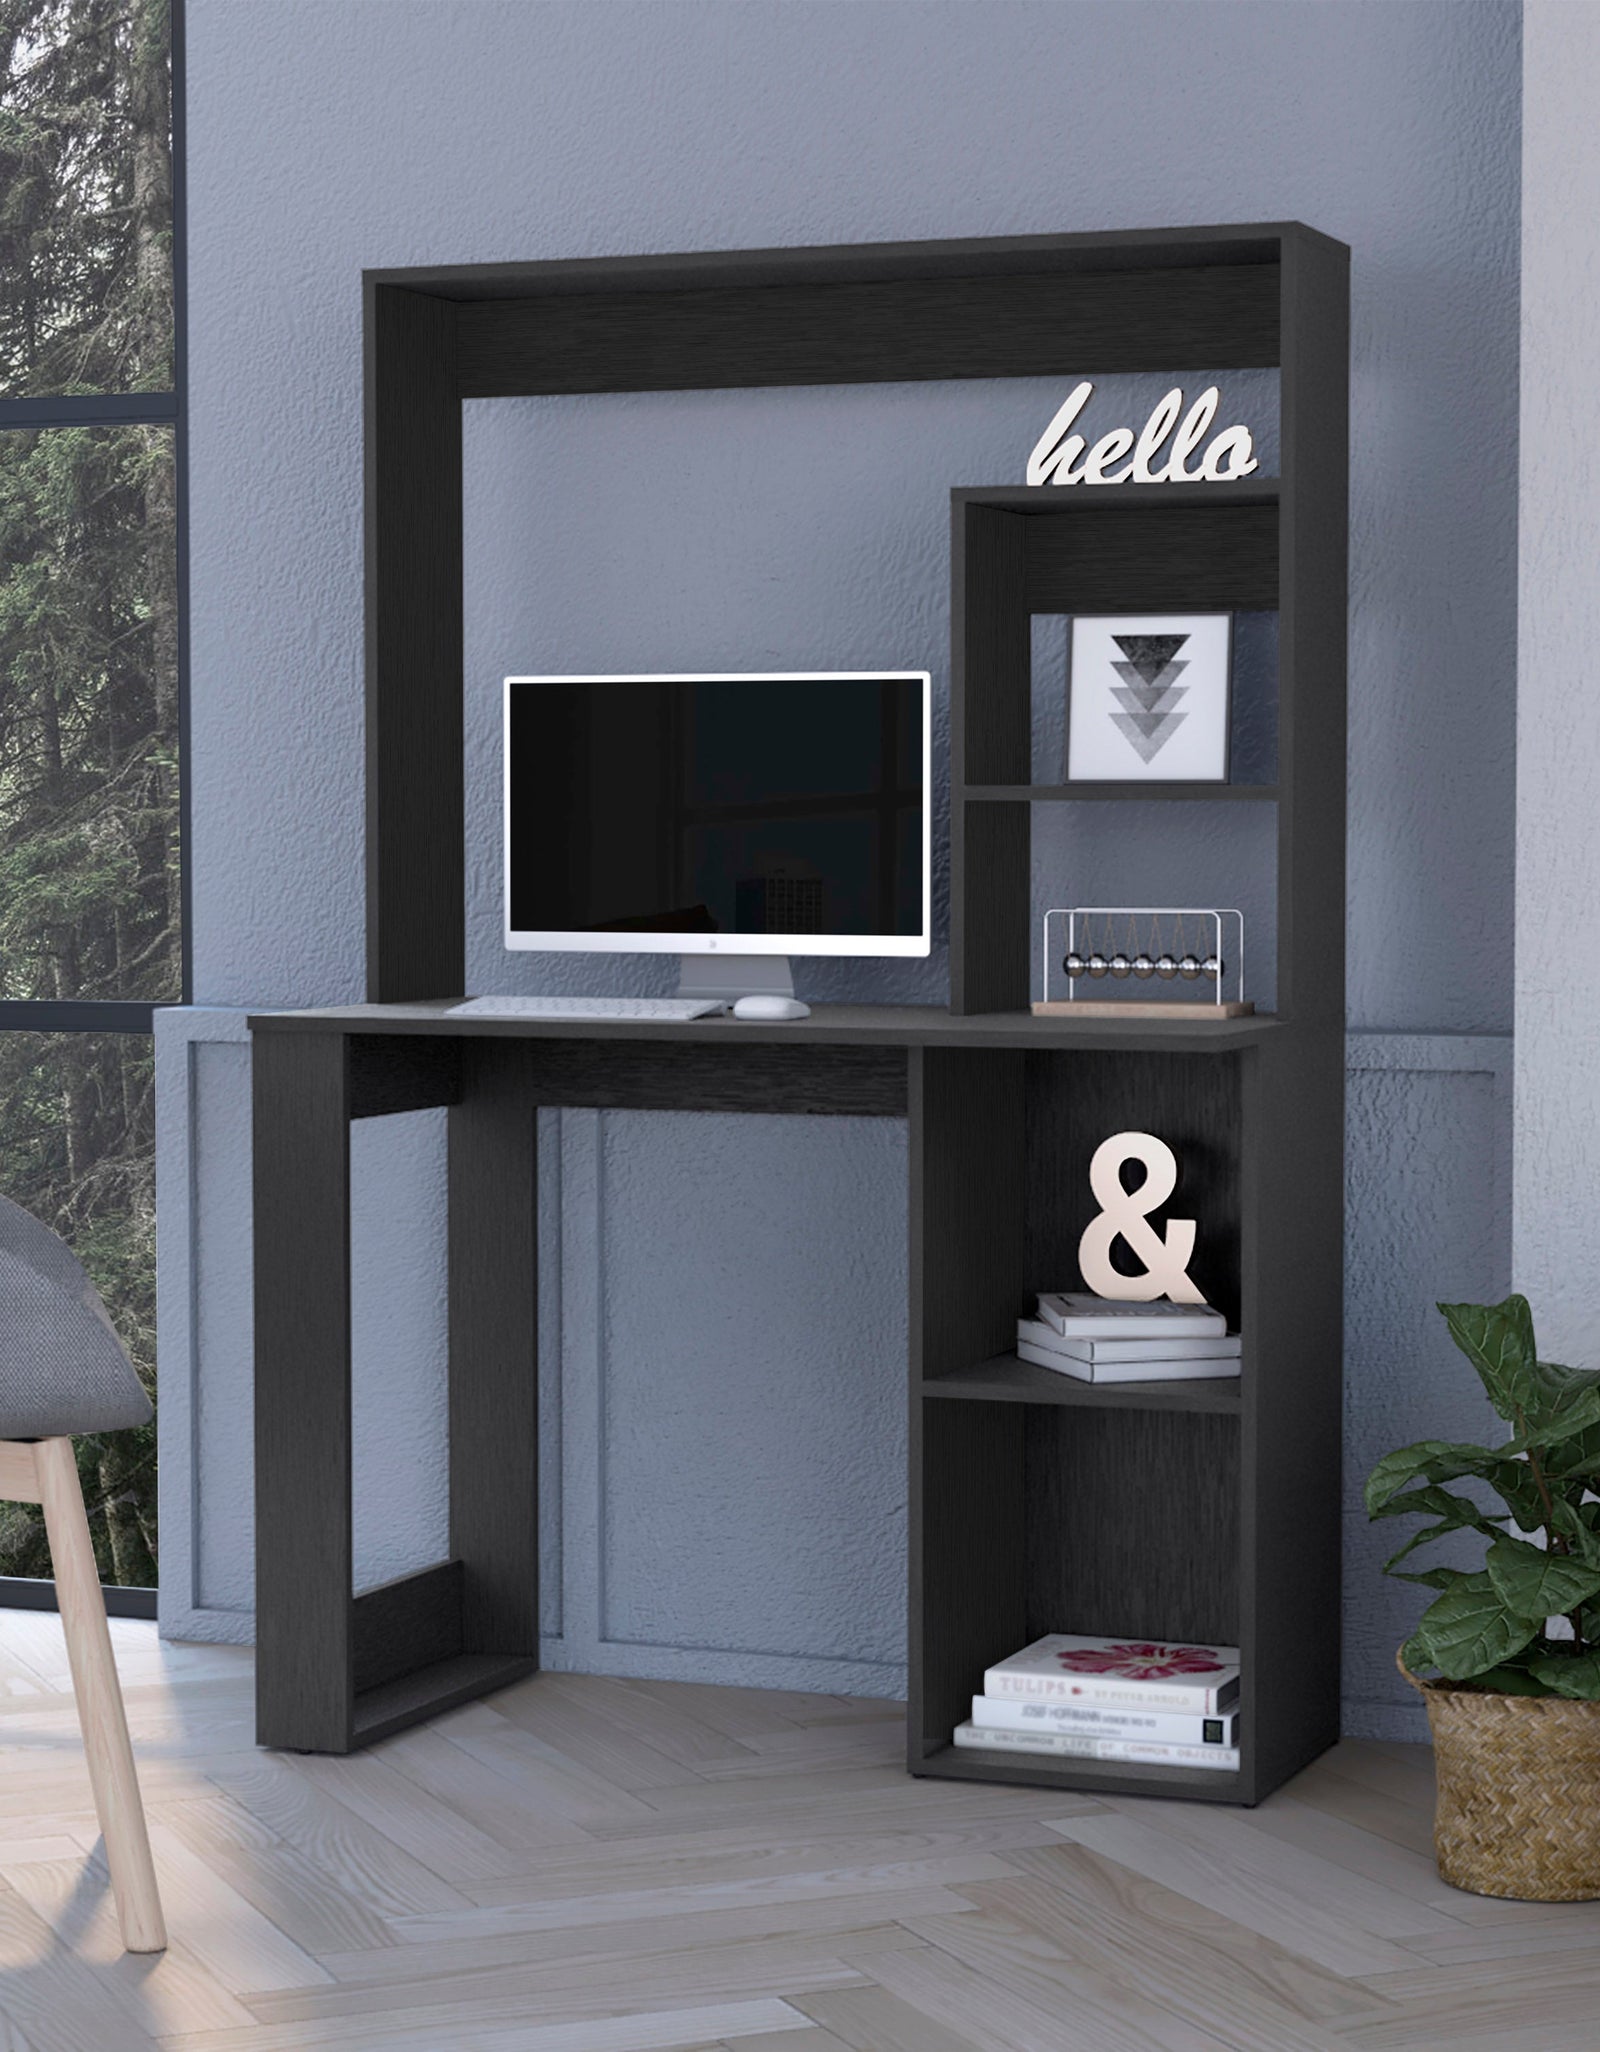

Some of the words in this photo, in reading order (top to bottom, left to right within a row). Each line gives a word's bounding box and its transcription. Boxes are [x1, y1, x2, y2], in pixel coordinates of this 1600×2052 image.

[1026, 381, 1259, 486] hello
[1078, 1131, 1207, 1304] &
[1000, 1677, 1066, 1695] TULIPS
[965, 1730, 985, 1740] THE
[994, 1733, 1055, 1746] UNCOMMON
[1062, 1739, 1092, 1749] LIFE
[1100, 1742, 1114, 1751] OF
[1123, 1744, 1170, 1756] COMMON
[1177, 1748, 1232, 1761] OBJECTS
